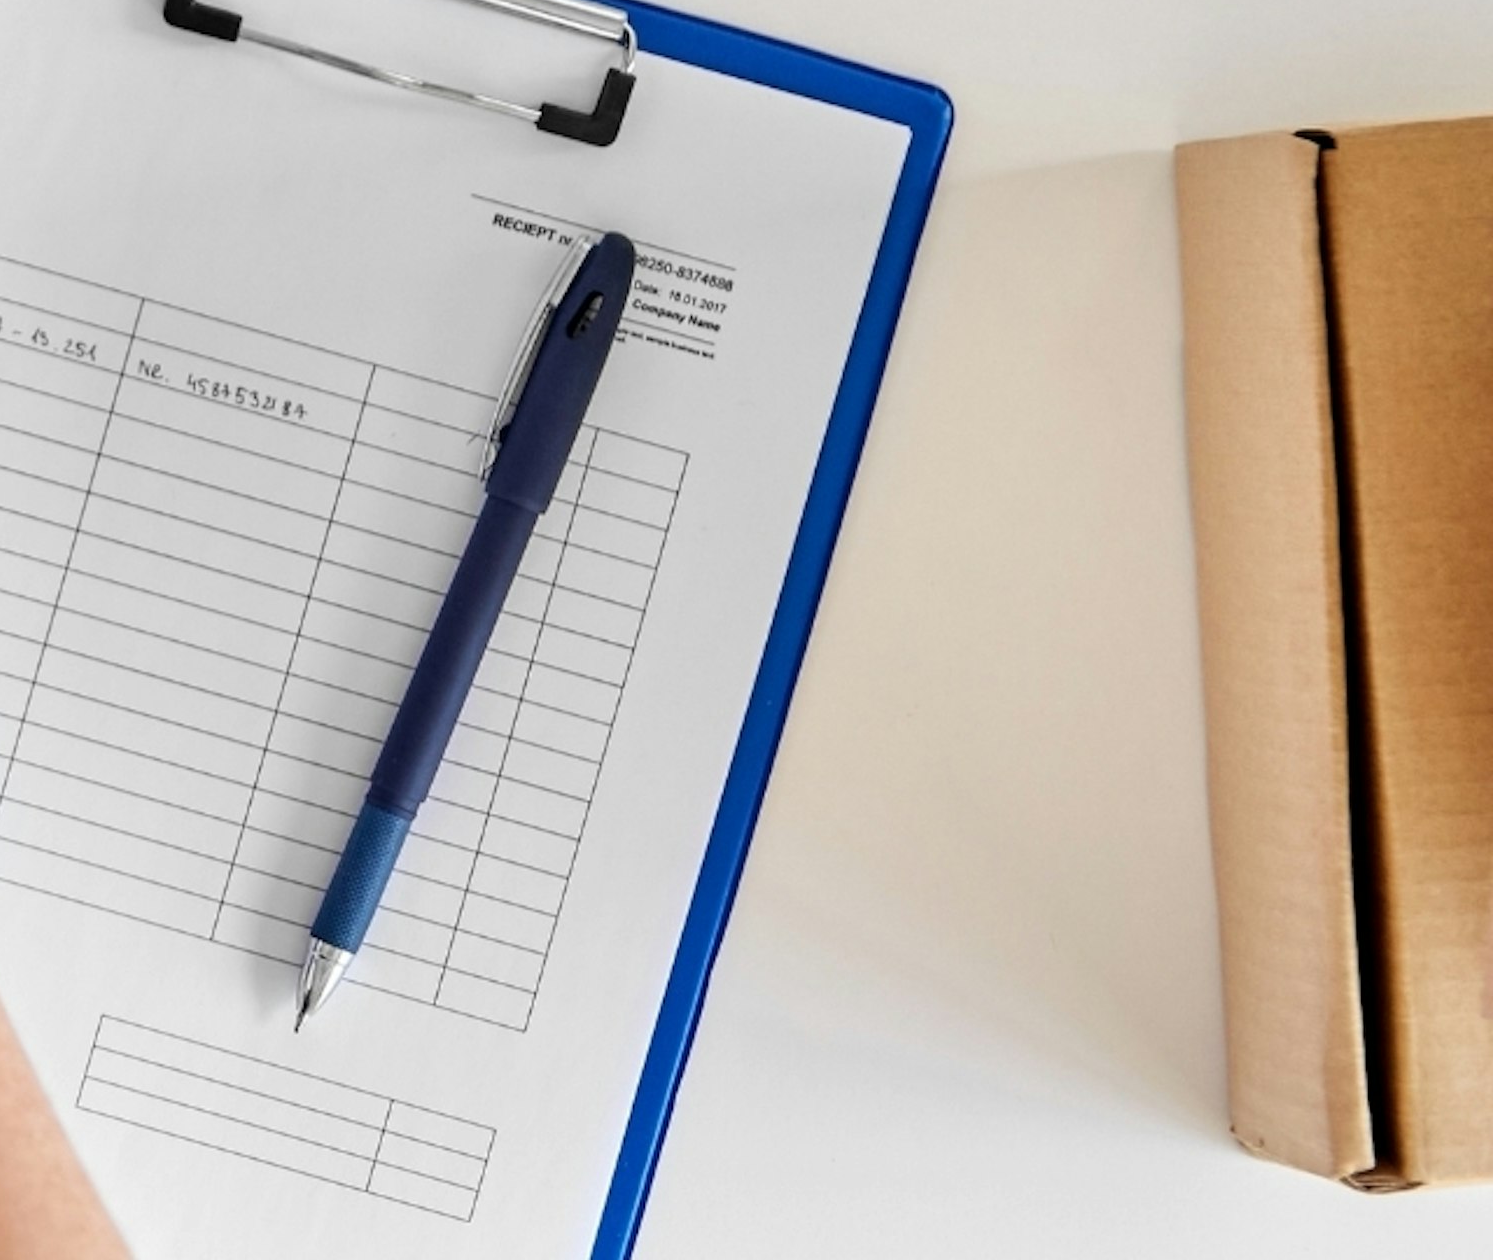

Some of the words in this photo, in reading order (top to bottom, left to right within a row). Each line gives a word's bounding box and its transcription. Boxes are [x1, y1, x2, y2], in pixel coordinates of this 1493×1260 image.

[492, 212, 557, 241] RECIEPT
[632, 298, 685, 324] Company
[688, 313, 721, 332] Name
